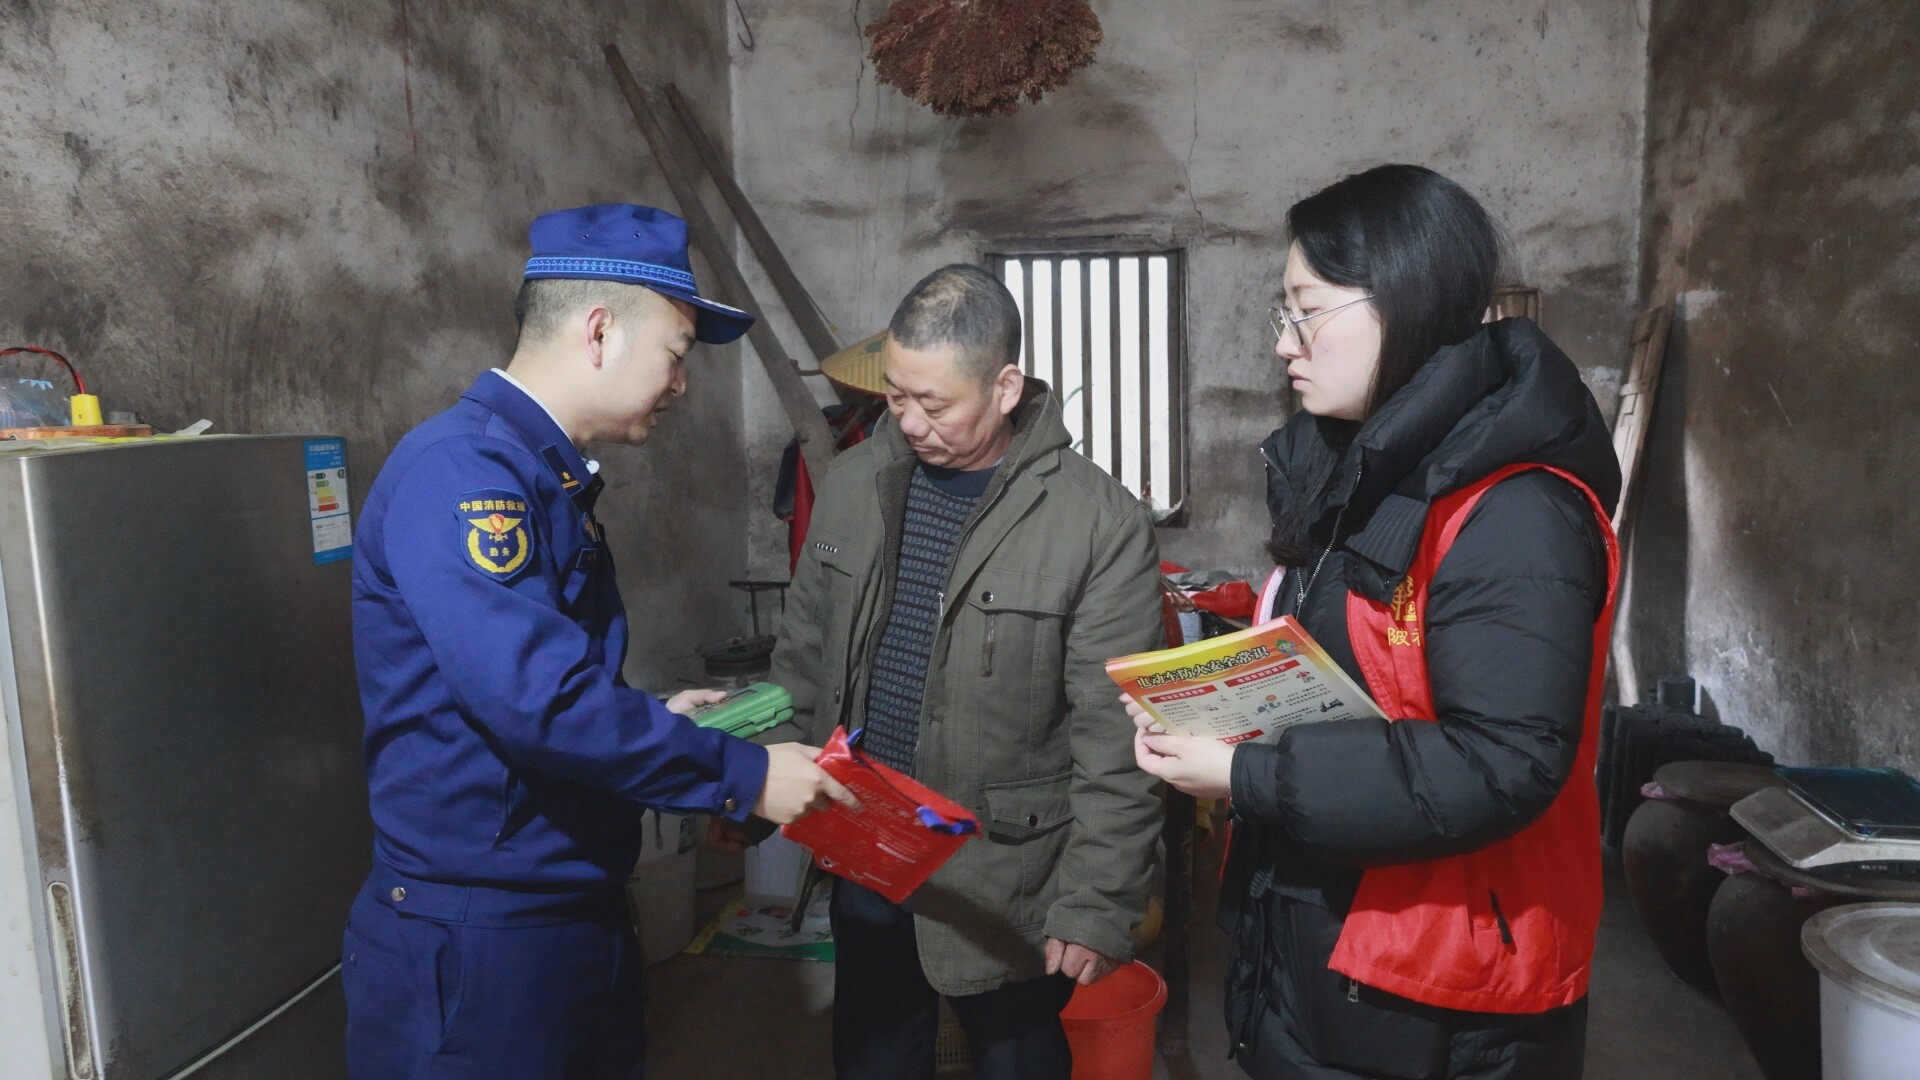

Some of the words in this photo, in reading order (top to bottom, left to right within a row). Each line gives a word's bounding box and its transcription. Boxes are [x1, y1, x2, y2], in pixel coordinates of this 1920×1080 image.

[460, 500, 526, 512] 中国消防救援
[1136, 645, 1270, 688] 电动车防火安全常识
